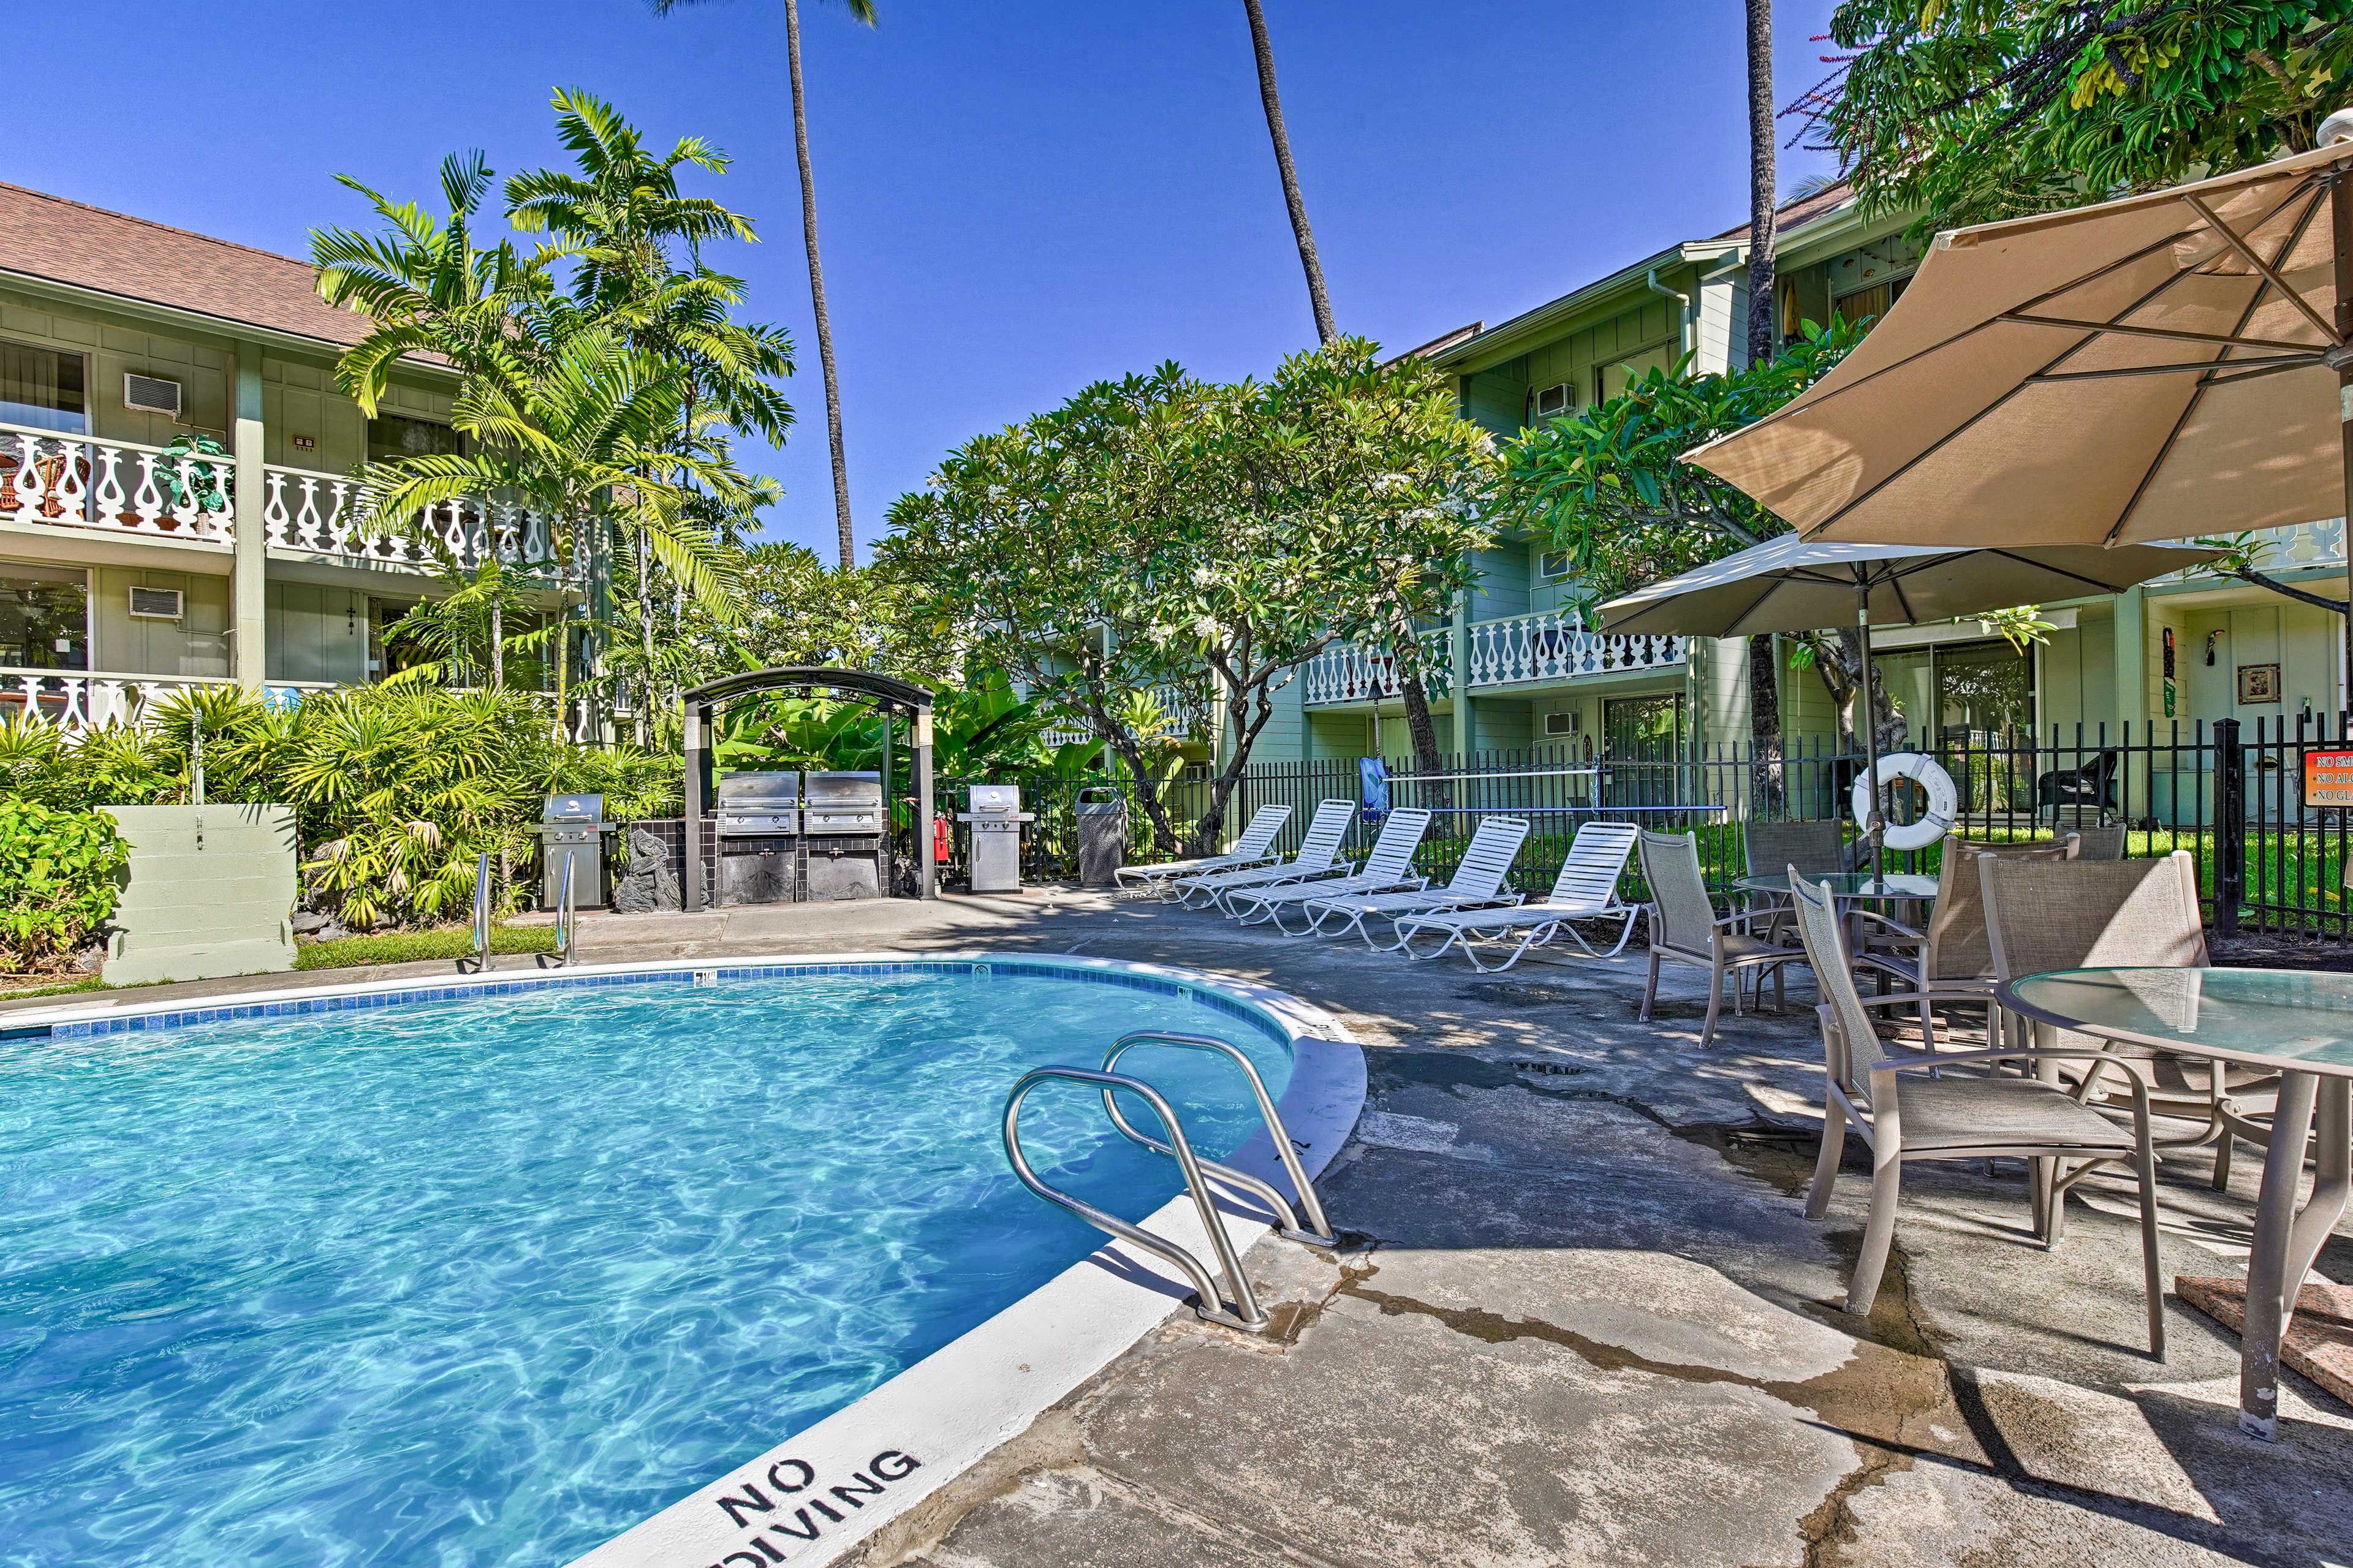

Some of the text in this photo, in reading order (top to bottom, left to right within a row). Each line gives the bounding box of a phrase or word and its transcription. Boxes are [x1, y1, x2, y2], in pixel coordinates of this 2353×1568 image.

[2317, 756, 2353, 768] NO SM
[2317, 773, 2334, 784] NO
[2317, 790, 2334, 801] NO
[716, 1458, 815, 1528] NO
